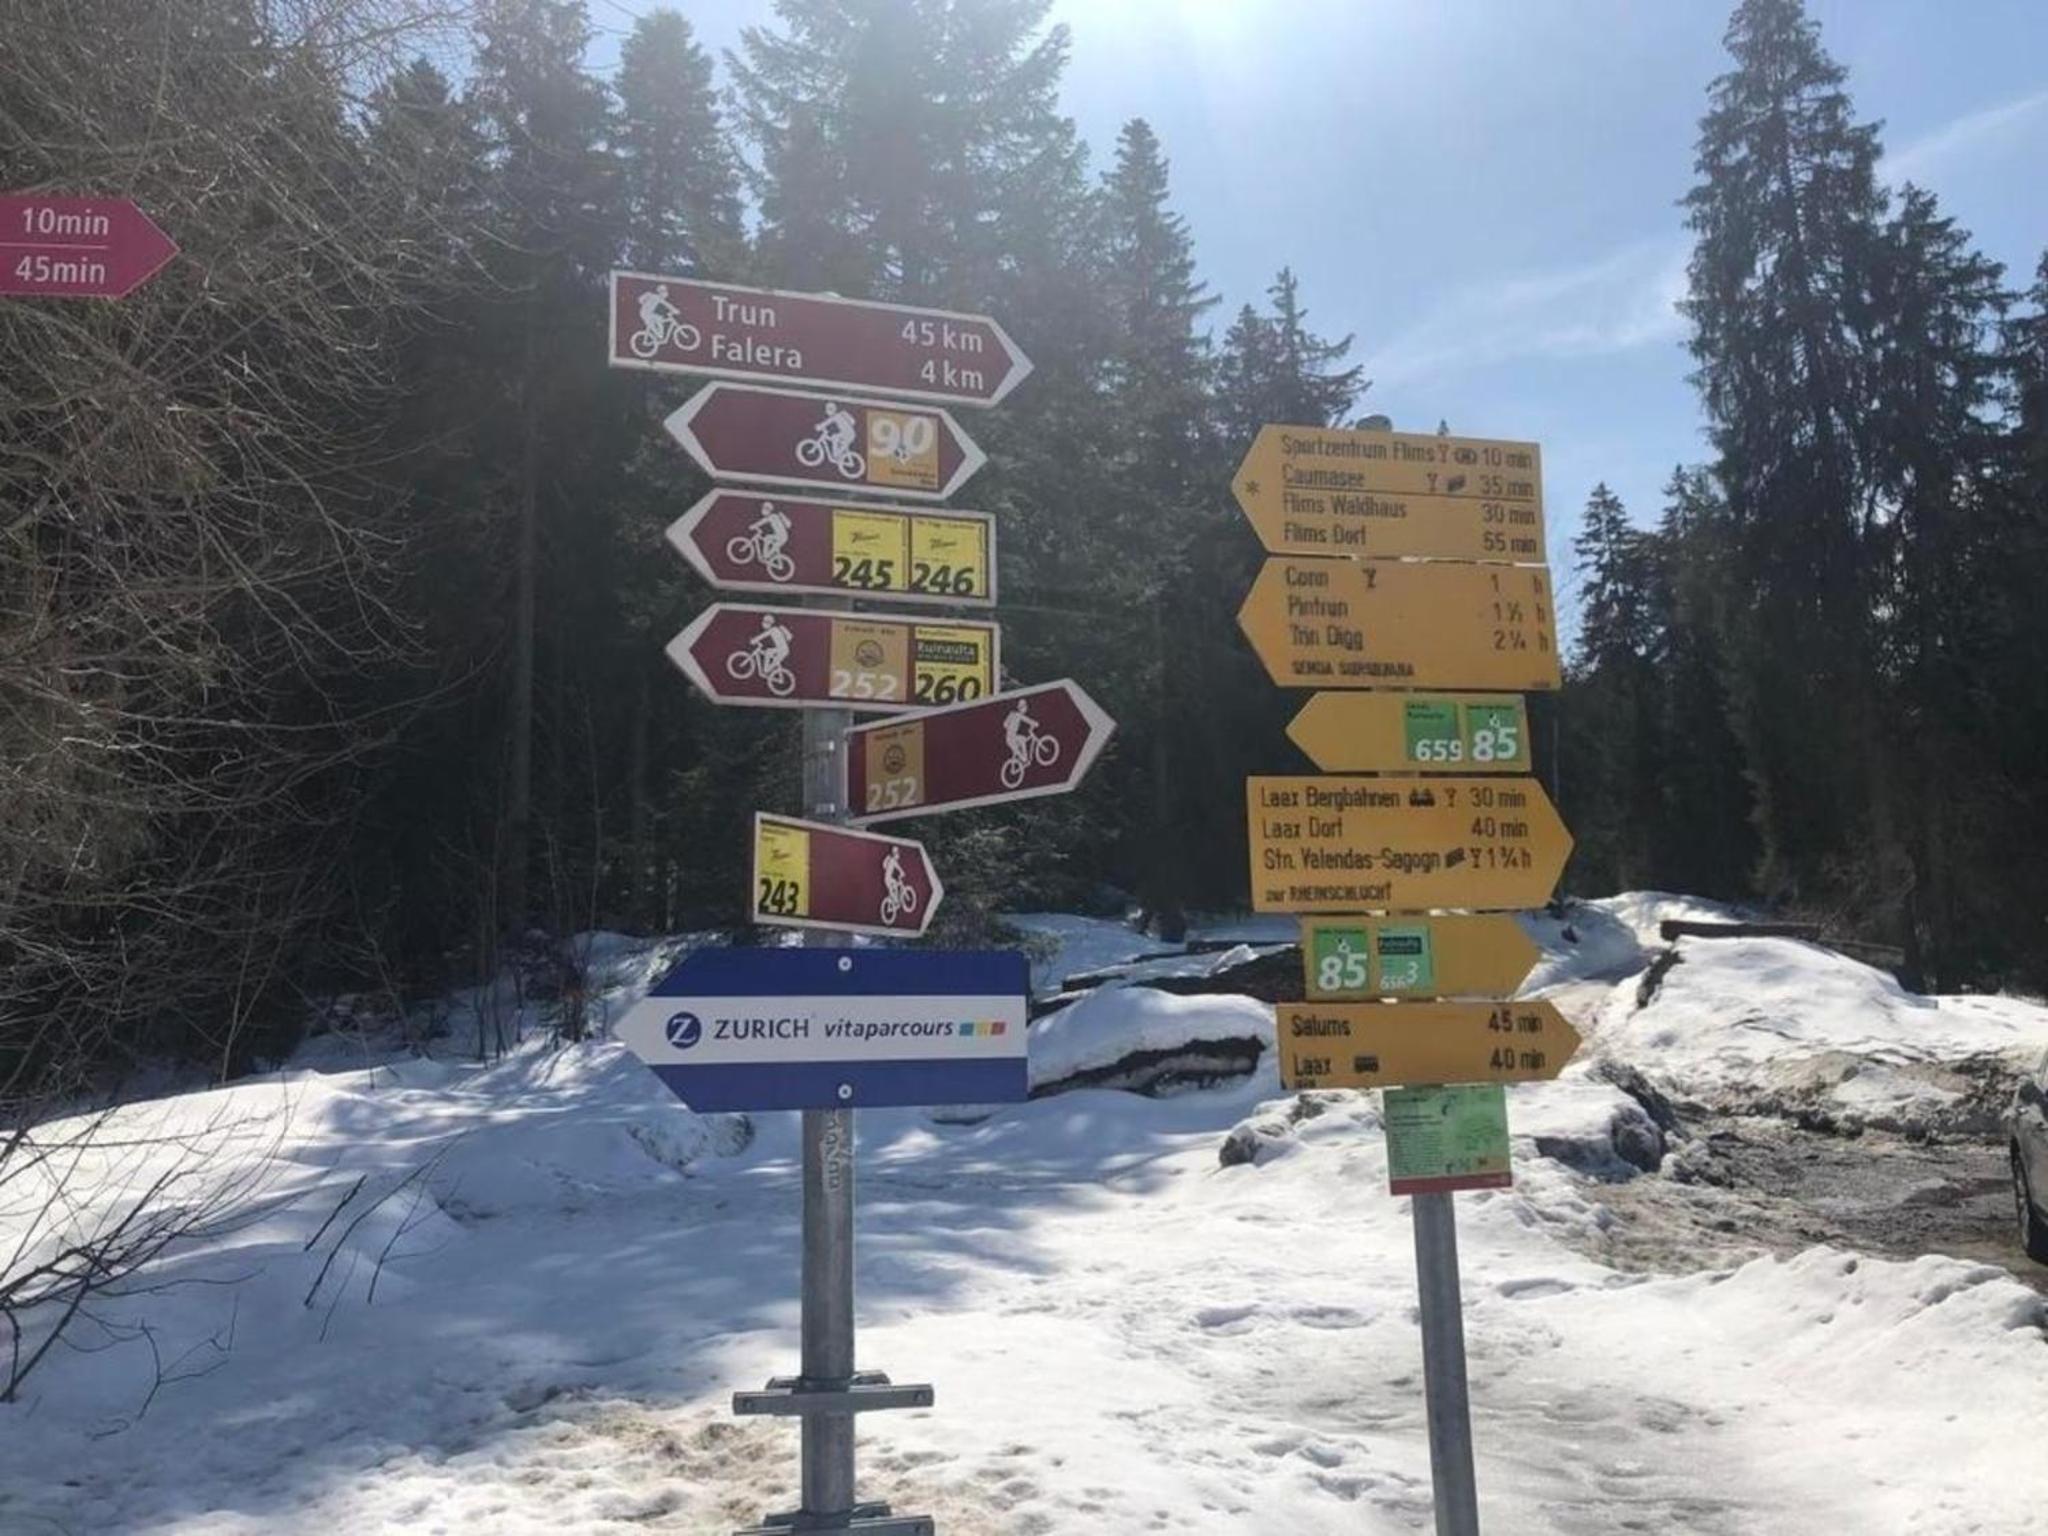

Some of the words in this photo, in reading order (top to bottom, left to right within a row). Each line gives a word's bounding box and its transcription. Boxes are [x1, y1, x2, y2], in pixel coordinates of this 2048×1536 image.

[23, 206, 109, 236] 10min
[15, 255, 106, 284] 45min
[711, 295, 777, 328] Trun
[901, 319, 937, 348] 45
[942, 321, 983, 354] km
[711, 334, 803, 369] Falera
[920, 359, 938, 383] 4
[943, 360, 985, 391] km
[871, 415, 934, 457] 90
[1282, 434, 1388, 459] Sportzentrum
[1393, 441, 1436, 462] Flims
[1482, 447, 1502, 467] 10
[1506, 452, 1533, 470] min
[1282, 463, 1365, 487] Caumasee
[1480, 475, 1502, 495] 35
[1507, 481, 1534, 498] min
[1283, 493, 1325, 515] Flims
[1331, 497, 1407, 519] Waldhaus
[1482, 503, 1505, 524] 30
[1509, 509, 1536, 526] min
[1284, 522, 1328, 544] Flims
[1333, 525, 1366, 546] Dorf
[1511, 537, 1537, 554] min
[833, 555, 894, 591] 245
[910, 561, 974, 594] 246
[1286, 566, 1329, 587] Conn
[1289, 623, 1320, 646] Trin
[1327, 625, 1364, 651] Digg
[830, 669, 897, 701] 252
[916, 673, 982, 706] 260
[1415, 739, 1463, 761] 659
[1472, 727, 1518, 762] 85
[866, 777, 917, 812] 252
[1261, 786, 1299, 807] Laax
[1305, 787, 1401, 812] Bergbahnen
[1470, 787, 1496, 807] 30
[1499, 788, 1526, 808] min
[1263, 817, 1300, 838] Laax
[1309, 816, 1343, 838] Dorf
[1471, 817, 1496, 838] 40
[1500, 818, 1528, 838] min
[757, 876, 799, 915] 243
[1318, 953, 1367, 990] 85
[713, 1018, 809, 1040] ZURICH
[824, 1018, 953, 1042] vitaparcours
[1292, 1015, 1350, 1037] Salums
[1488, 1011, 1513, 1032] 45
[1517, 1013, 1542, 1033] min
[1294, 1054, 1331, 1076] Laax
[1490, 1051, 1515, 1070] 40
[1520, 1050, 1546, 1070] min
